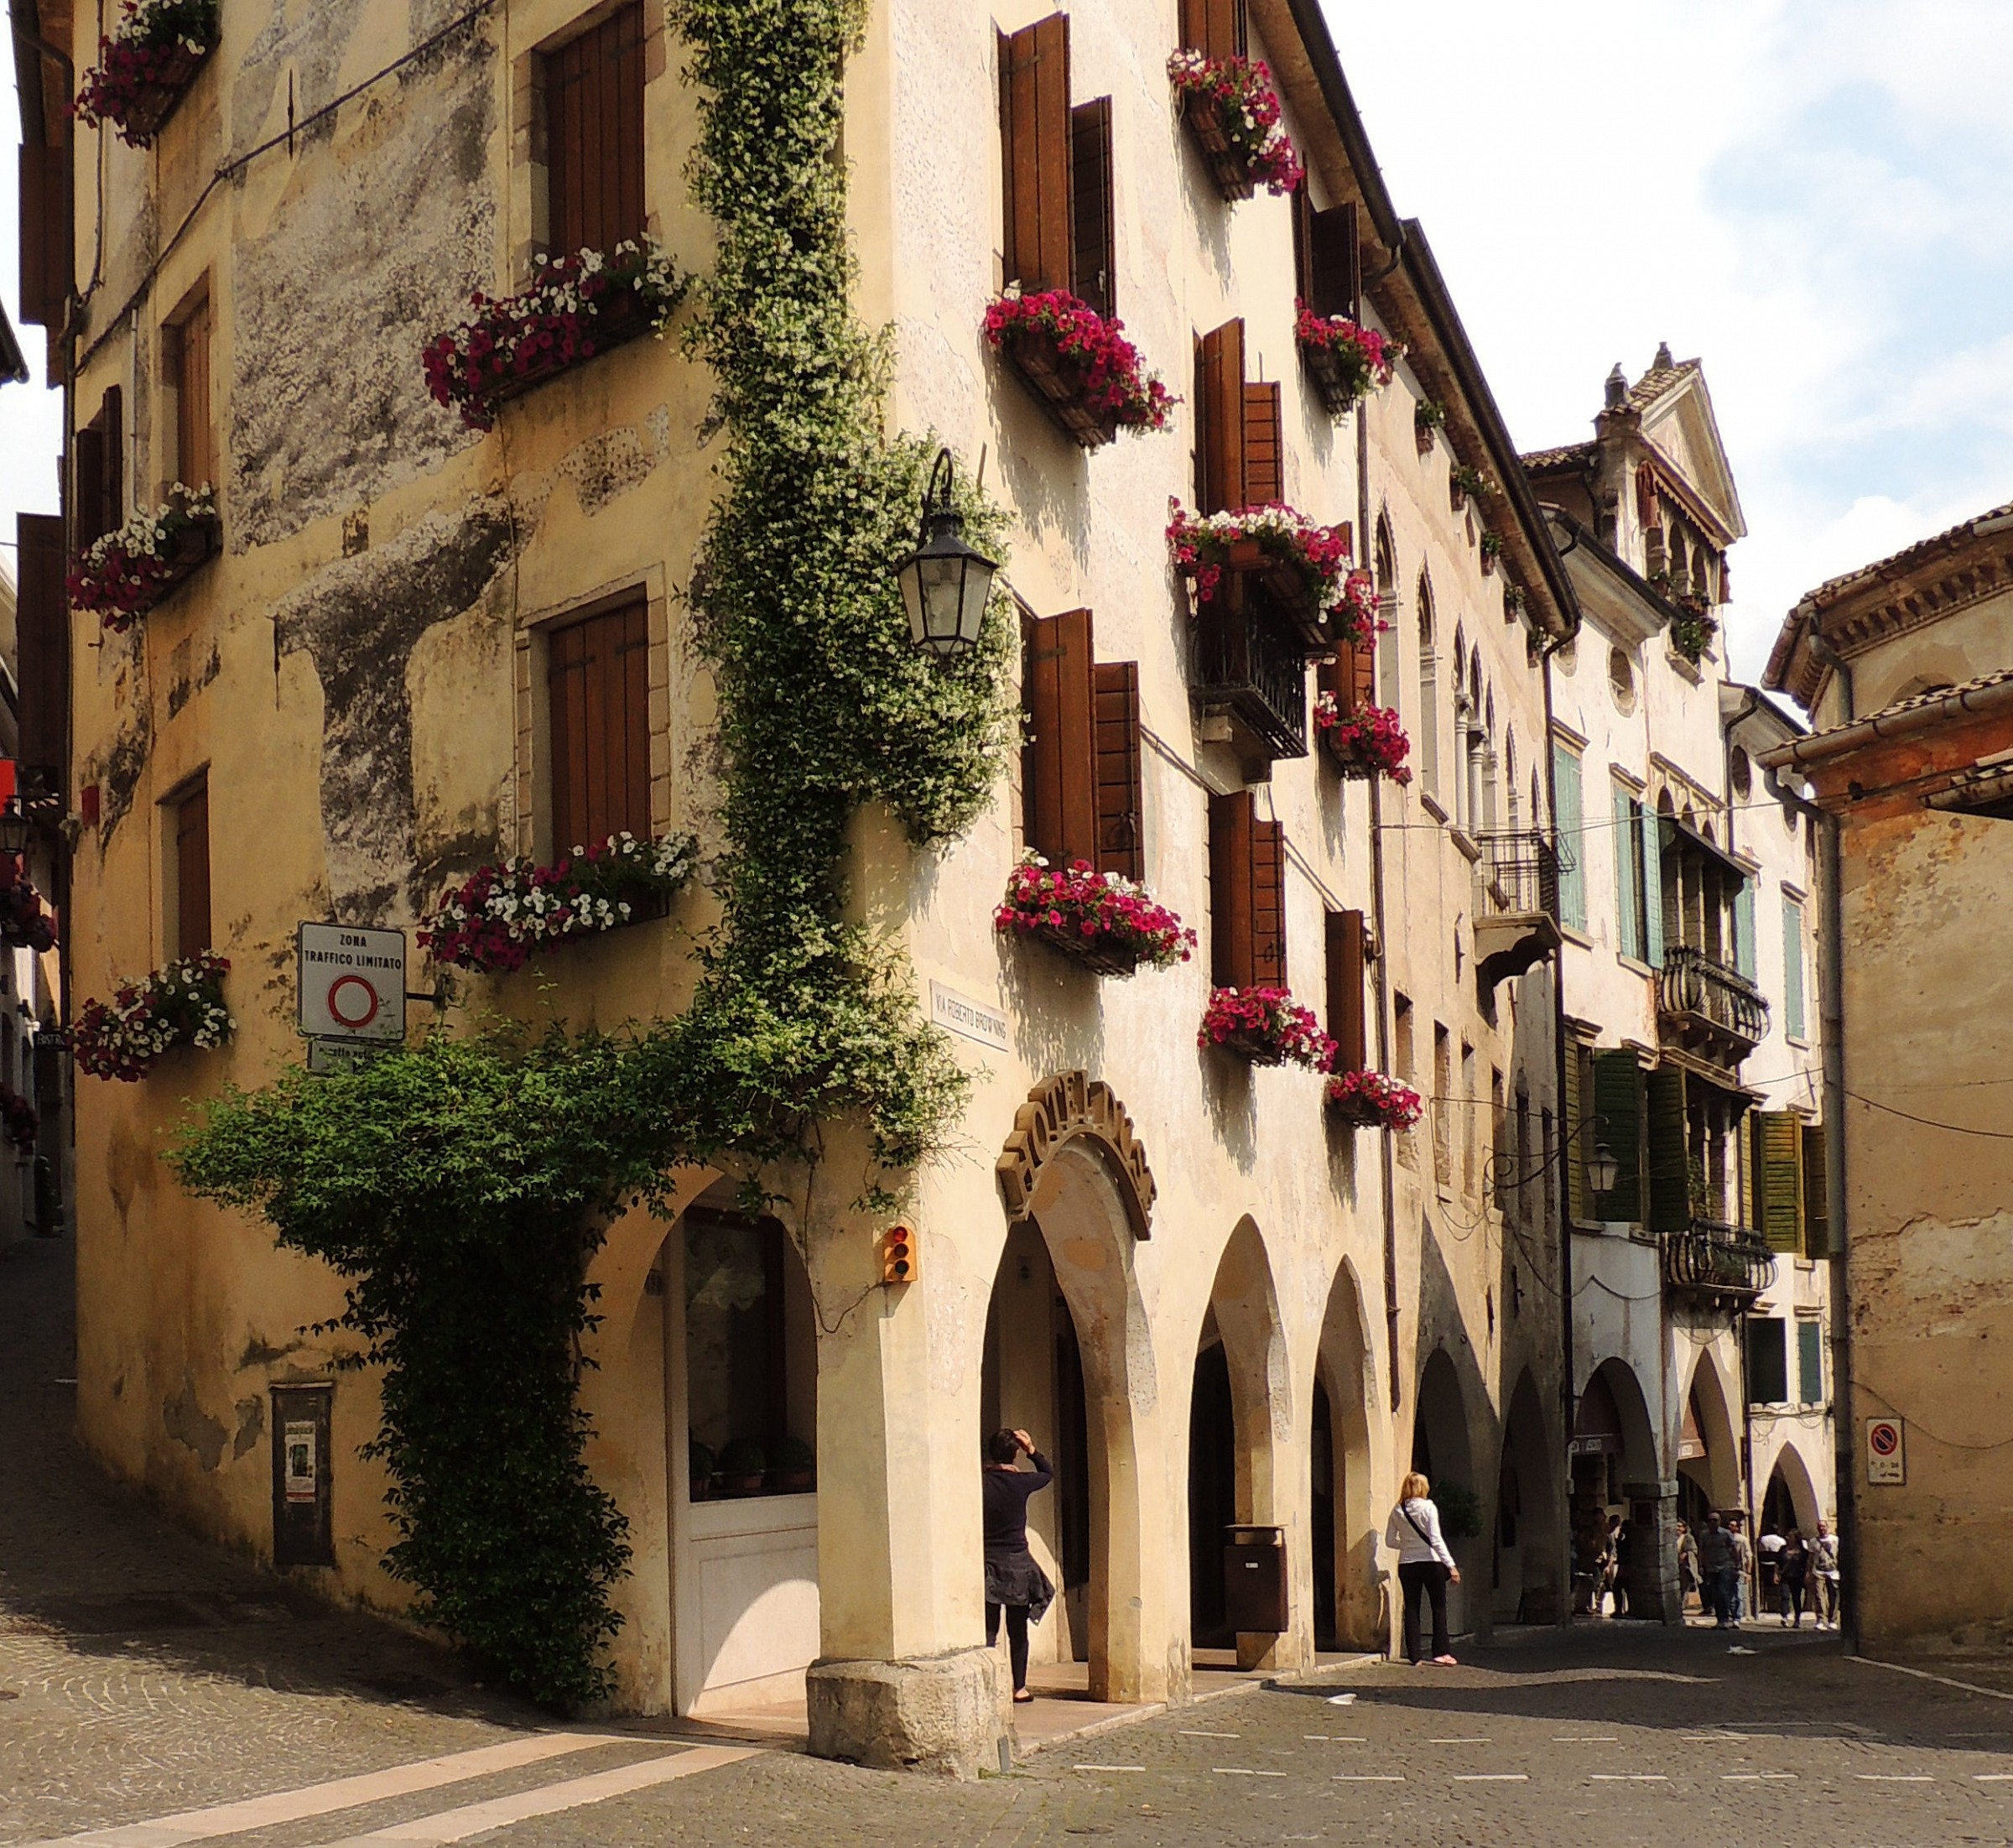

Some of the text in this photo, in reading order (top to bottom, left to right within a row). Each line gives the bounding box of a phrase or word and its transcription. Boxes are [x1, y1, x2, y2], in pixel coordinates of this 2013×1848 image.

[340, 934, 367, 947] ZONA
[304, 950, 402, 971] TRAFFICO LIMITATO
[936, 992, 946, 1014] VIA
[948, 997, 974, 1027] ROBERTO
